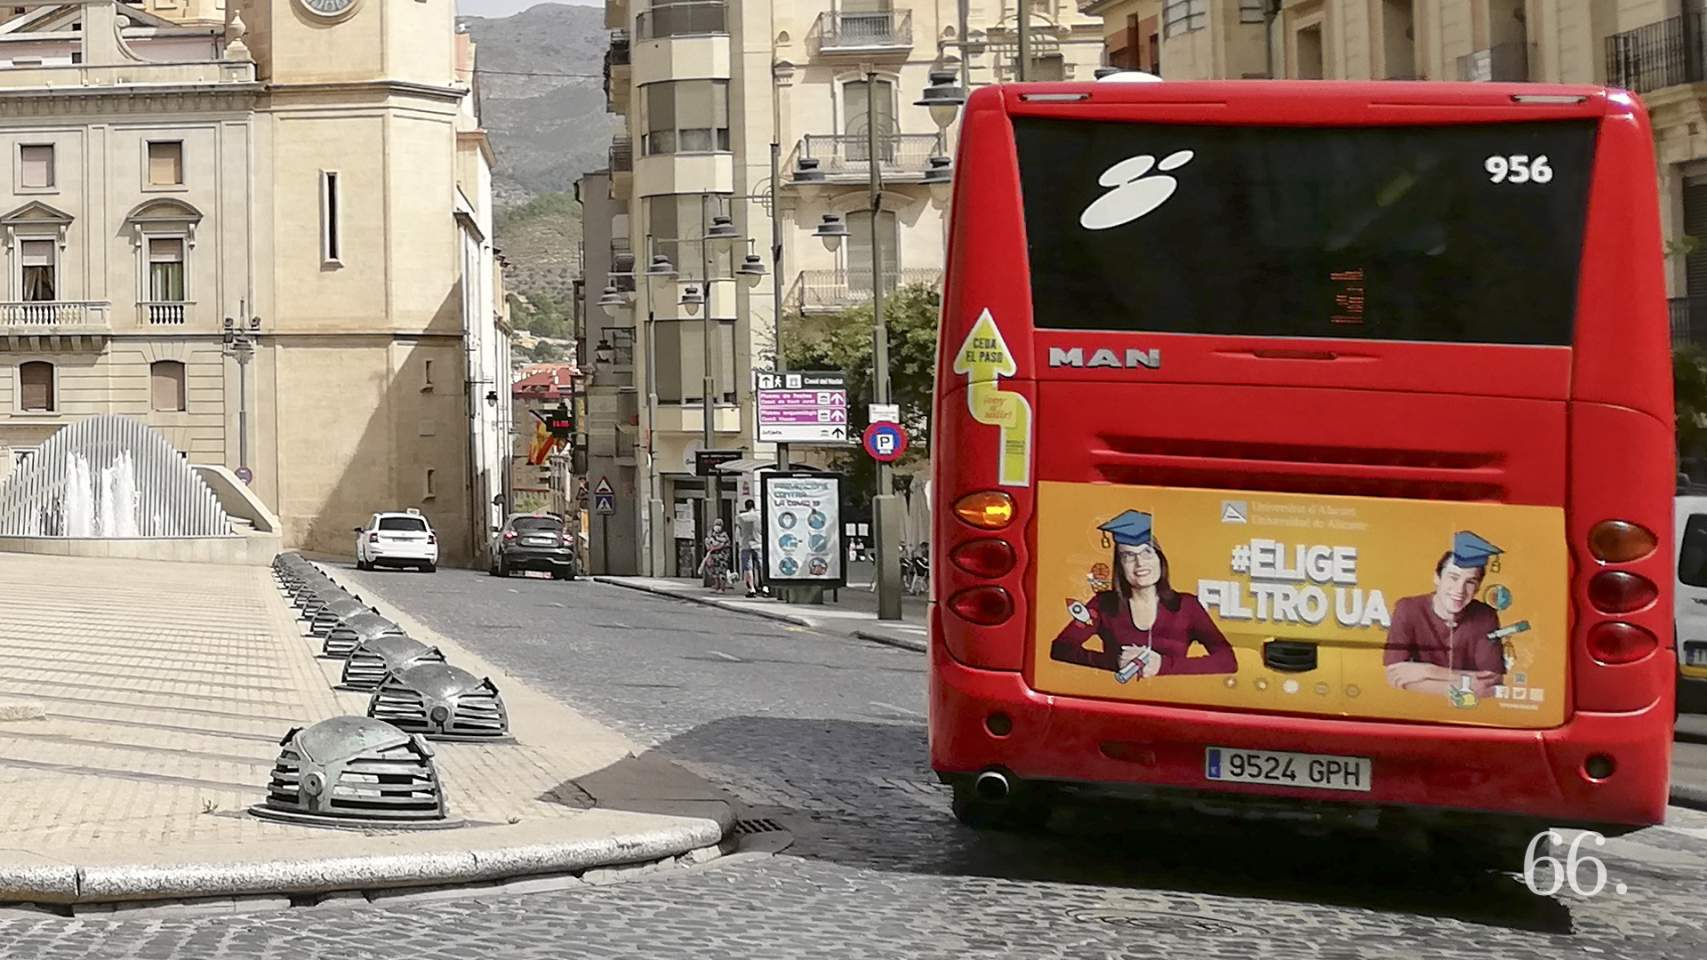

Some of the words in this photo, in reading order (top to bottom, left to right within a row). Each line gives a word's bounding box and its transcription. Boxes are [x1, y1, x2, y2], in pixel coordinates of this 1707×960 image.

[1485, 155, 1553, 184] 956
[965, 350, 976, 362] EL
[979, 351, 1004, 363] PASO
[973, 337, 997, 349] CEDA
[1049, 347, 1160, 368] MAN
[1231, 538, 1357, 585] #ELIGE
[1198, 578, 1328, 625] FILTRO
[1335, 586, 1392, 629] UA
[1229, 753, 1297, 781] 9524
[1308, 759, 1361, 786] GPH
